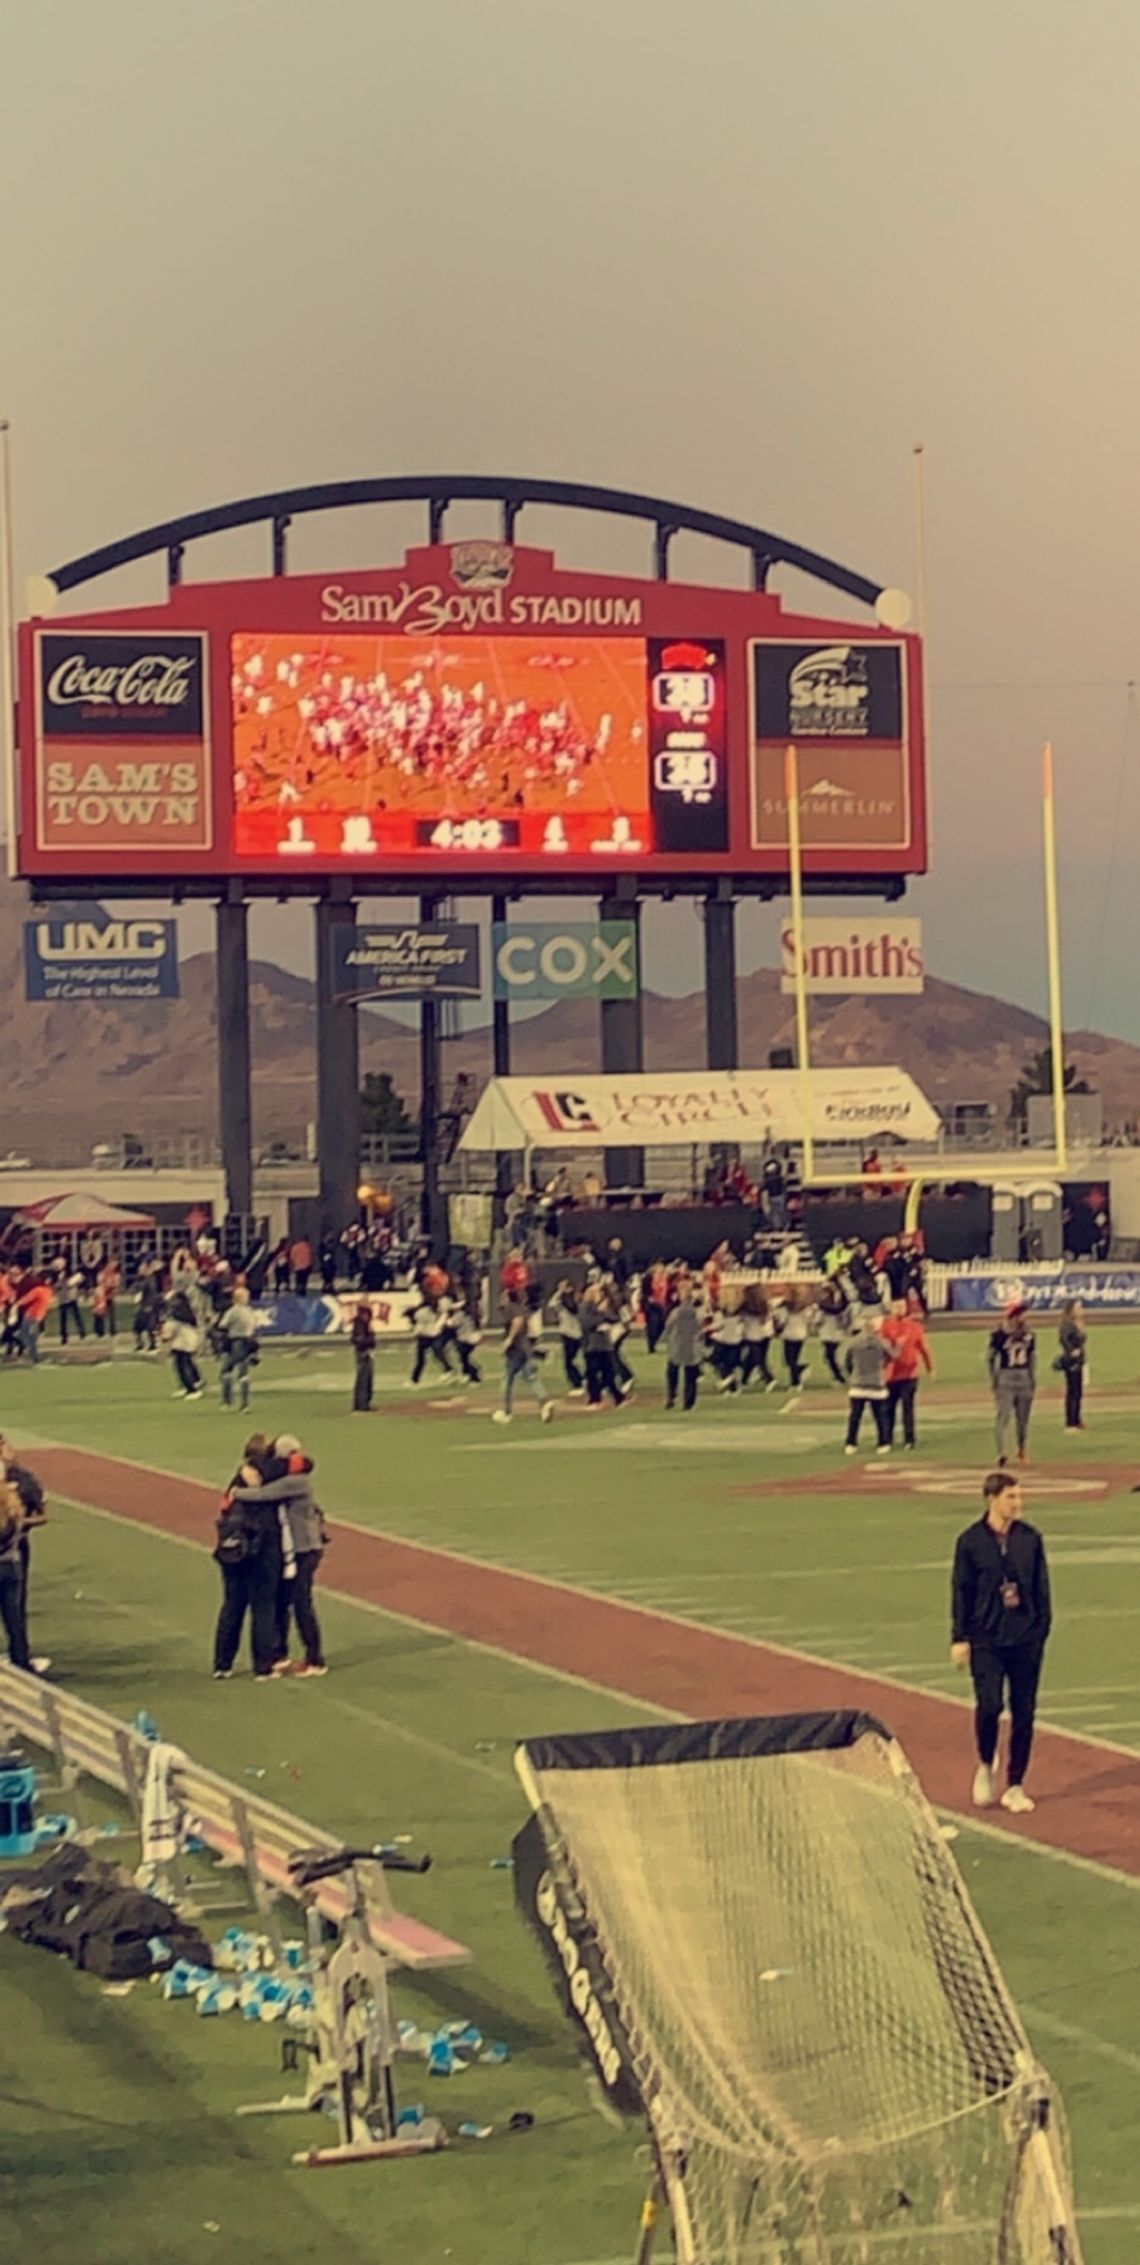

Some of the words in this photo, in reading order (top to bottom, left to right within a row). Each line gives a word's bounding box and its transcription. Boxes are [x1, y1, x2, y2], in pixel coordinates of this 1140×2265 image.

[321, 585, 393, 623] Sam
[391, 582, 502, 636] Boyd
[509, 595, 642, 626] STADIUM
[47, 654, 197, 705] Coca-Cola
[789, 680, 869, 709] Star
[48, 761, 198, 793] SAM'S
[48, 795, 199, 825] TOWN
[36, 922, 167, 961] UMC
[345, 949, 419, 965] AMERICA
[420, 949, 467, 964] FIRST
[497, 936, 633, 984] COX
[781, 928, 923, 978] Smith's
